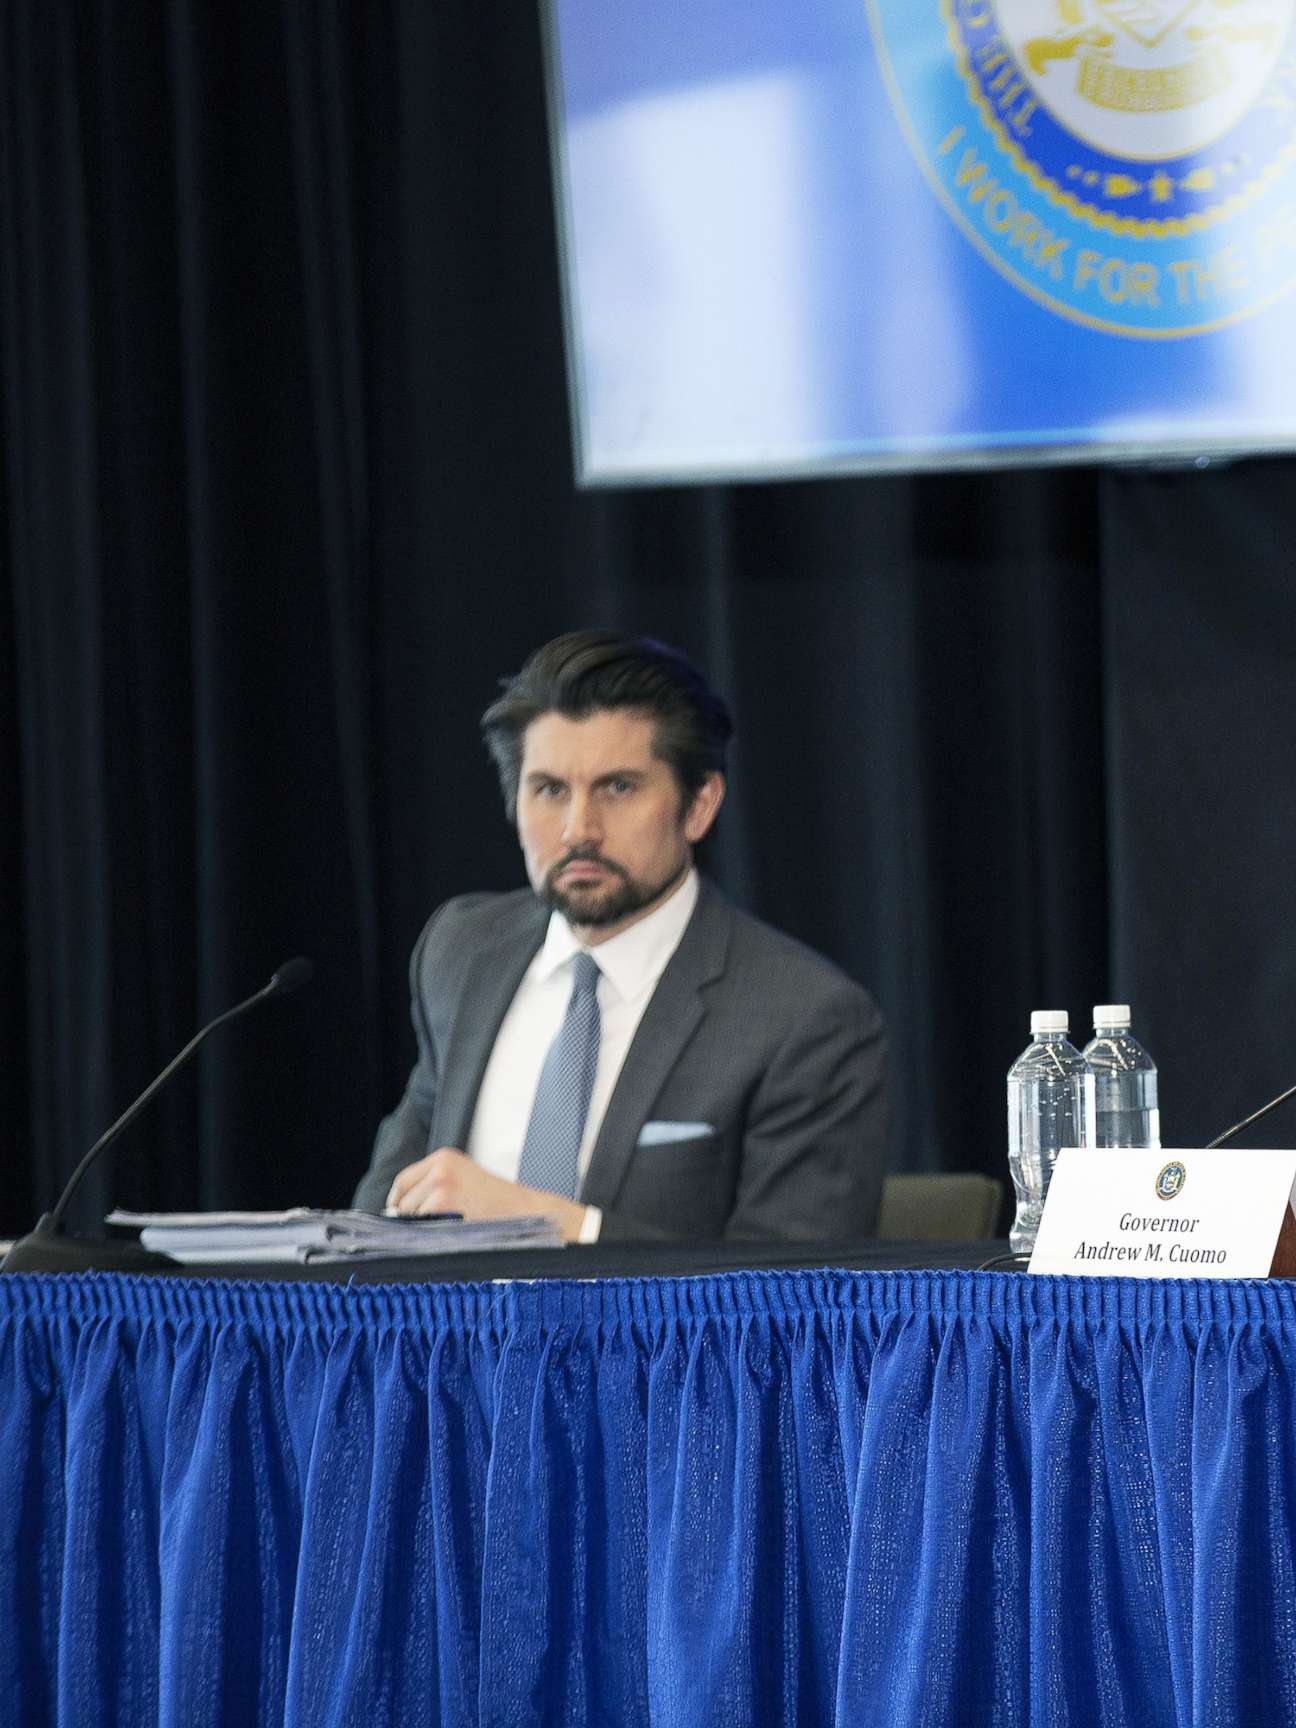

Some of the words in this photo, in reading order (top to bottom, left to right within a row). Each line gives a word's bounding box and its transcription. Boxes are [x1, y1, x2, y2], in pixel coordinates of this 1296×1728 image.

[937, 126, 966, 156] I
[955, 147, 1071, 280] WORK
[1072, 249, 1161, 306] FOR
[1169, 245, 1249, 305] THE
[1119, 1212, 1200, 1233] Governor
[1073, 1241, 1142, 1261] Andrew
[1144, 1243, 1163, 1262] M.
[1168, 1244, 1227, 1264] Cuomo
